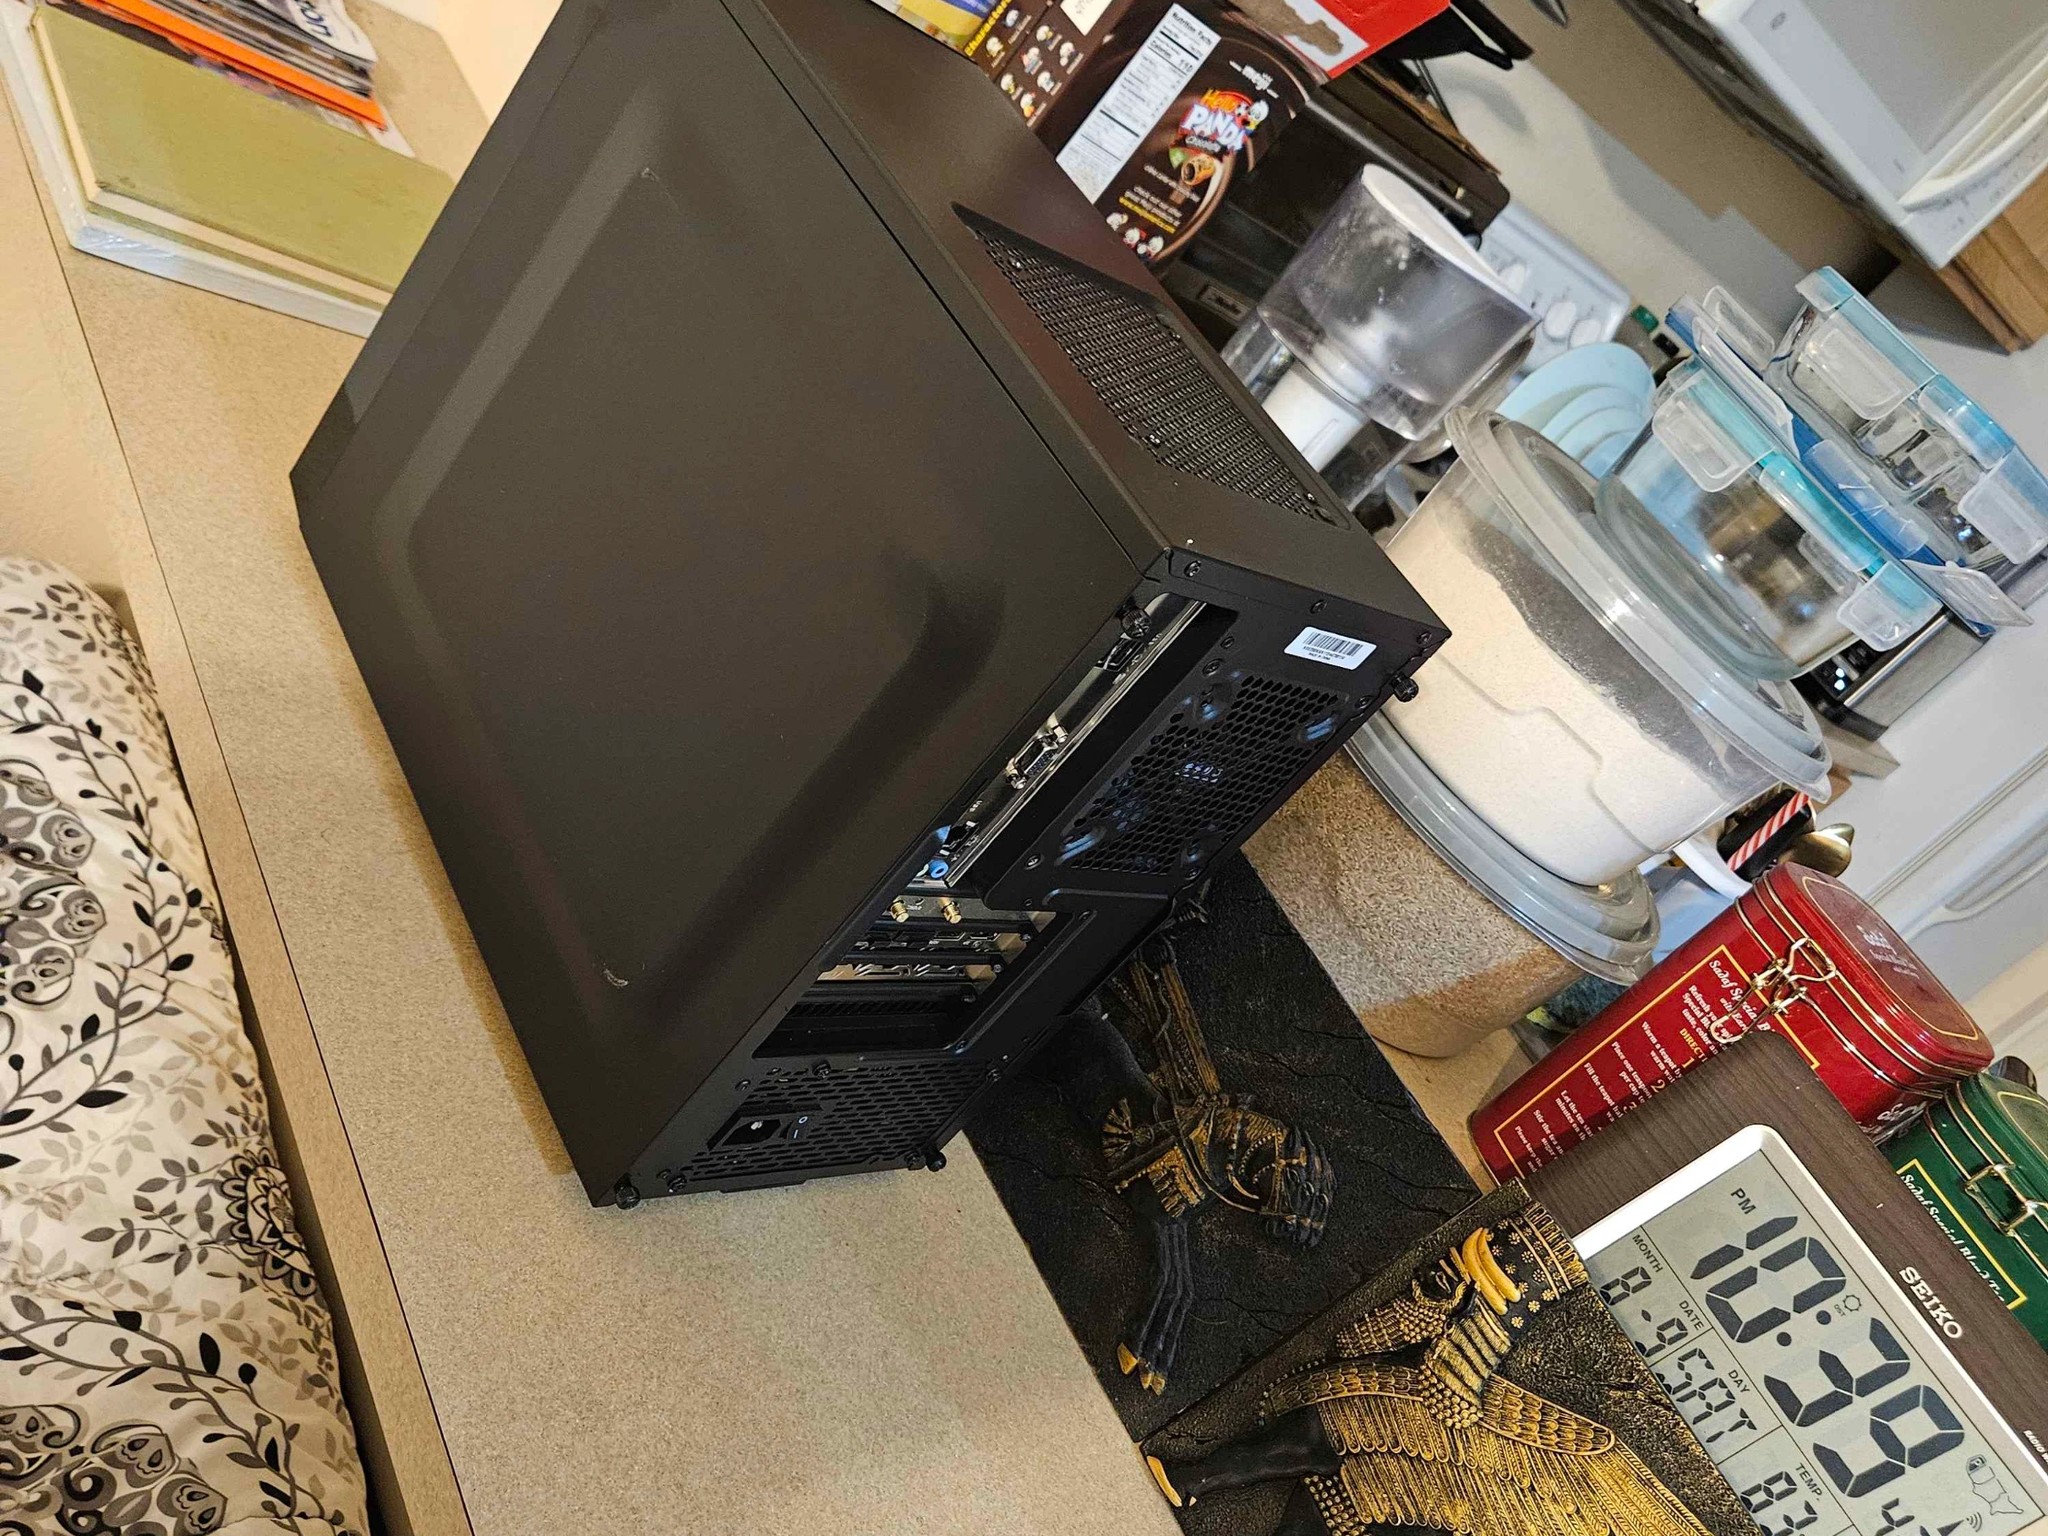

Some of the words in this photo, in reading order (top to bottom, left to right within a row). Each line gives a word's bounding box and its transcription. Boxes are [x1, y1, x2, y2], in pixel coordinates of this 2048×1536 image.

[1180, 102, 1245, 149] PANDA
[1709, 961, 1738, 988] Sadaf
[1682, 993, 1704, 1018] Special
[1688, 985, 1710, 1013] Refresh
[1706, 1011, 1724, 1028] yor
[1731, 1012, 1748, 1031] Ear
[1682, 1009, 1697, 1029] taste,
[1696, 1027, 1712, 1045] color
[1611, 1041, 1626, 1060] Place
[1623, 1059, 1634, 1072] one
[1642, 1021, 1657, 1044] Warm
[1659, 1048, 1677, 1070] teapot
[1674, 1068, 1682, 1078] by
[1650, 1050, 1666, 1070] warm
[1682, 1057, 1695, 1068] 1
[1584, 1062, 1595, 1075] Fill
[1591, 1074, 1601, 1086] the
[1598, 1085, 1615, 1106] teapot
[1619, 1071, 1631, 1083] per
[1629, 1083, 1640, 1096] cup
[1650, 1079, 1665, 1093] 2
[1555, 1097, 1574, 1124] minutes
[1572, 1123, 1580, 1132] on
[1561, 1090, 1571, 1103] Let
[1568, 1102, 1578, 1114] the
[1576, 1113, 1584, 1124] tea
[1515, 1126, 1528, 1144] Please
[1525, 1142, 1536, 1158] keep
[1533, 1109, 1544, 1123] Stir
[1542, 1123, 1551, 1134] the
[1549, 1134, 1558, 1145] tea
[1556, 1145, 1564, 1154] an
[1541, 1137, 1555, 1156] sugar
[1730, 1187, 1756, 1215] PM
[1632, 1234, 1663, 1273] MONTH
[1679, 1300, 1704, 1331] DATE
[1899, 1266, 1963, 1339] SEIKO
[1690, 1216, 1964, 1500] 10:39
[1655, 1347, 1757, 1443] SAT
[1728, 1369, 1750, 1393] DAY
[2024, 1430, 2046, 1452] RADIO
[1795, 1462, 1822, 1501] TEMP.
